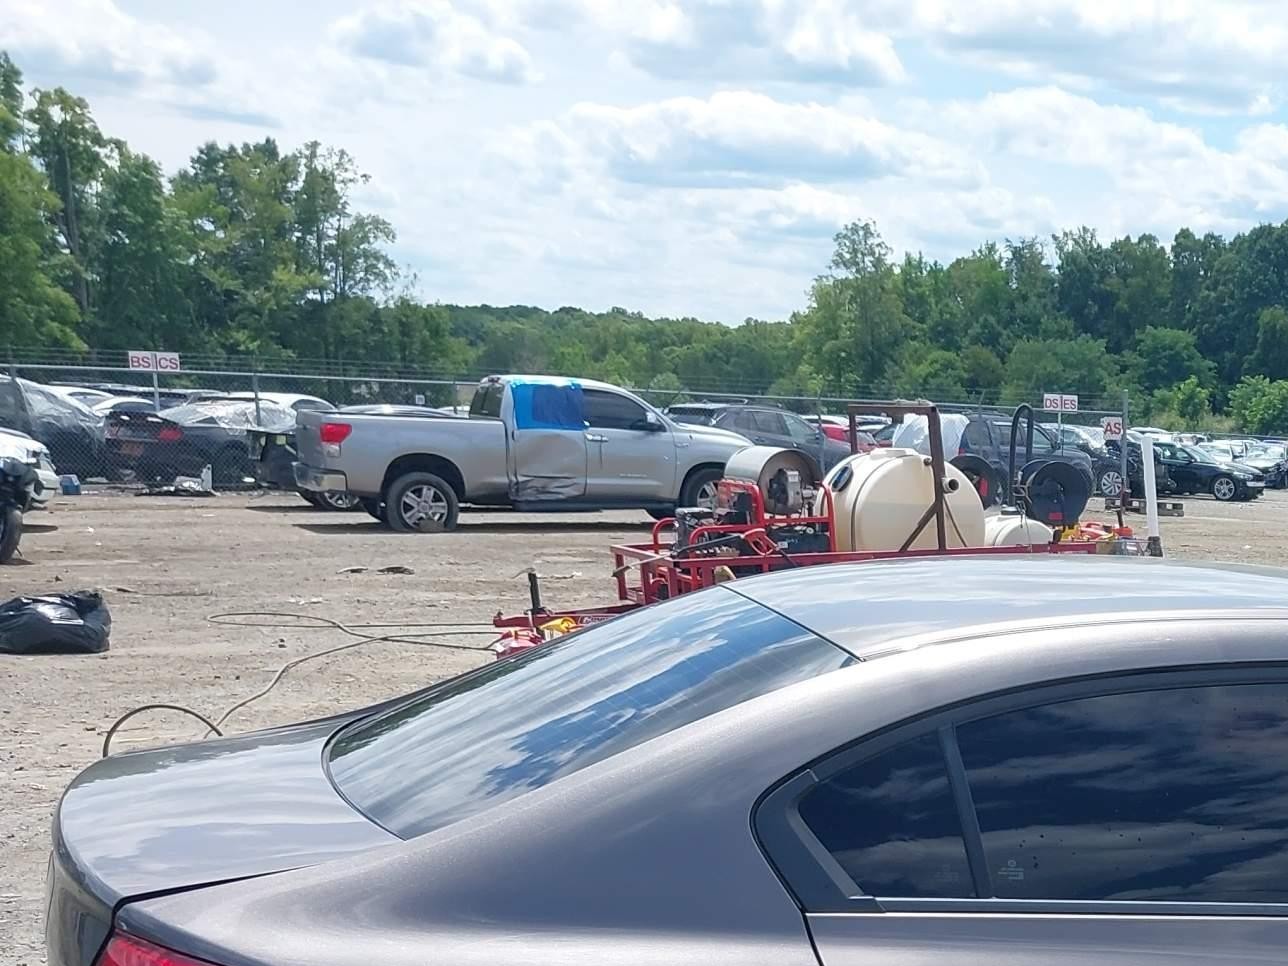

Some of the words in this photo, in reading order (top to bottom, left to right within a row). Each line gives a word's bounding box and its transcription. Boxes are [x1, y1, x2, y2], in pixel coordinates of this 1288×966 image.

[130, 356, 151, 369] BS
[158, 356, 179, 370] CS
[1045, 398, 1059, 409] DS
[1063, 398, 1077, 410] ES
[1104, 422, 1122, 435] AS
